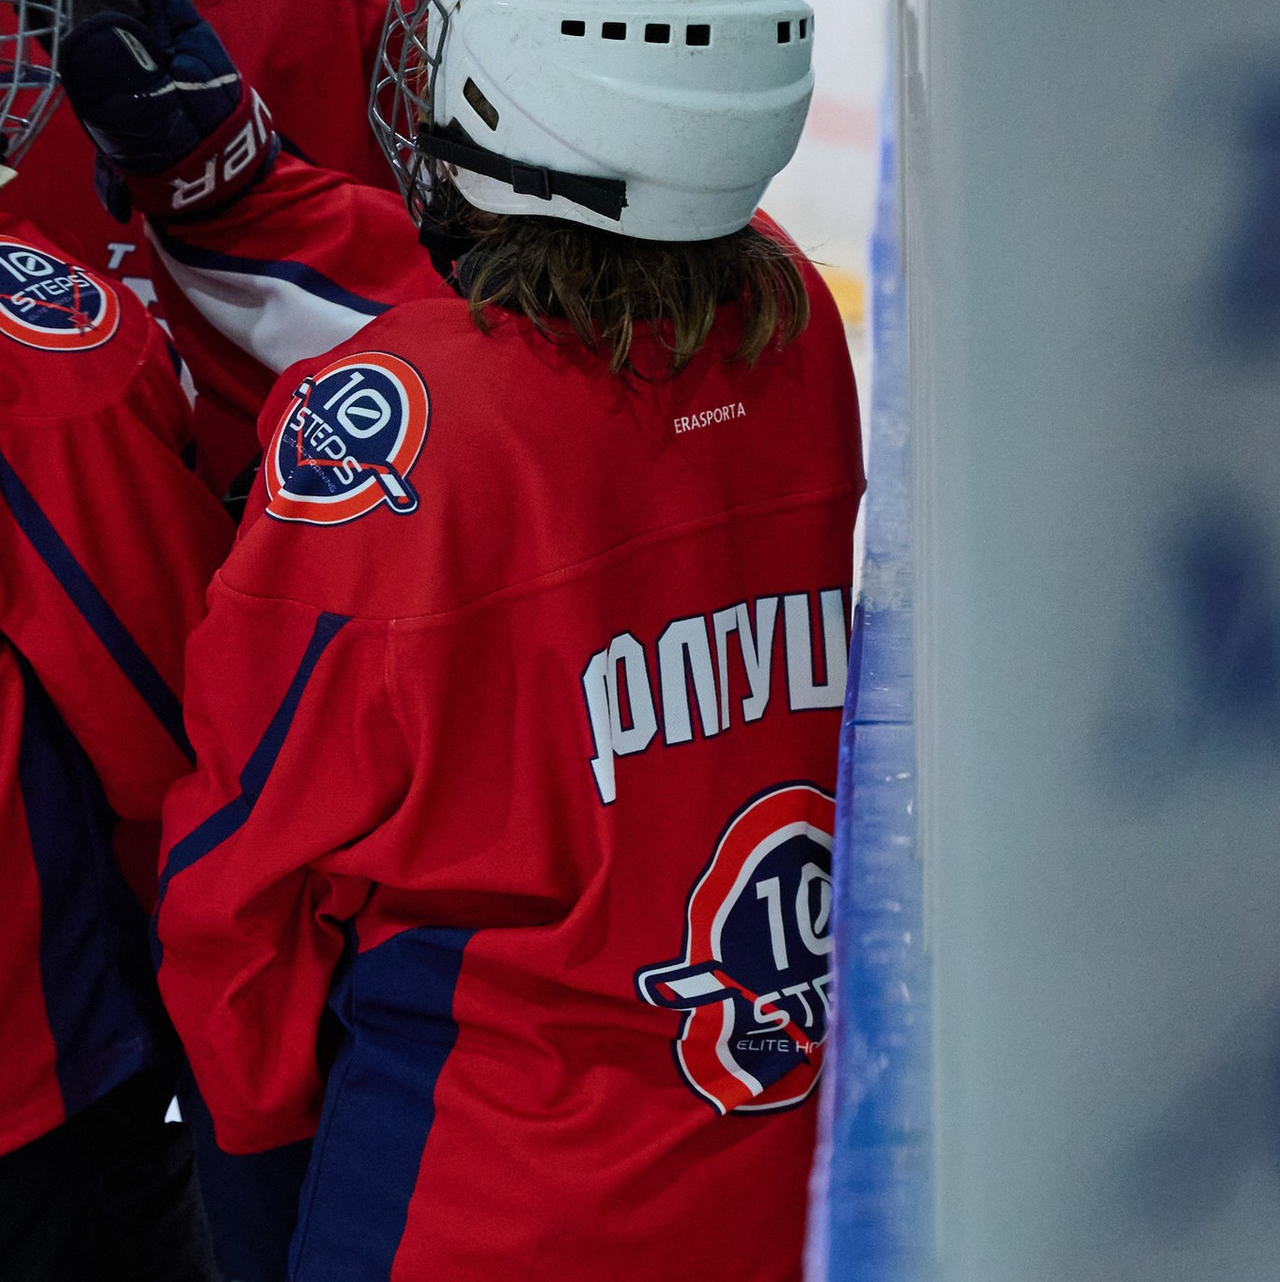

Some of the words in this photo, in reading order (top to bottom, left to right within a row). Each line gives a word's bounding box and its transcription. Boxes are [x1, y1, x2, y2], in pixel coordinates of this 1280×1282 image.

[11, 274, 90, 313] STEPS
[323, 371, 392, 439] 10
[673, 402, 747, 435] ERASPORTA
[289, 406, 363, 486] STEPS
[736, 1039, 789, 1053] ELITE
